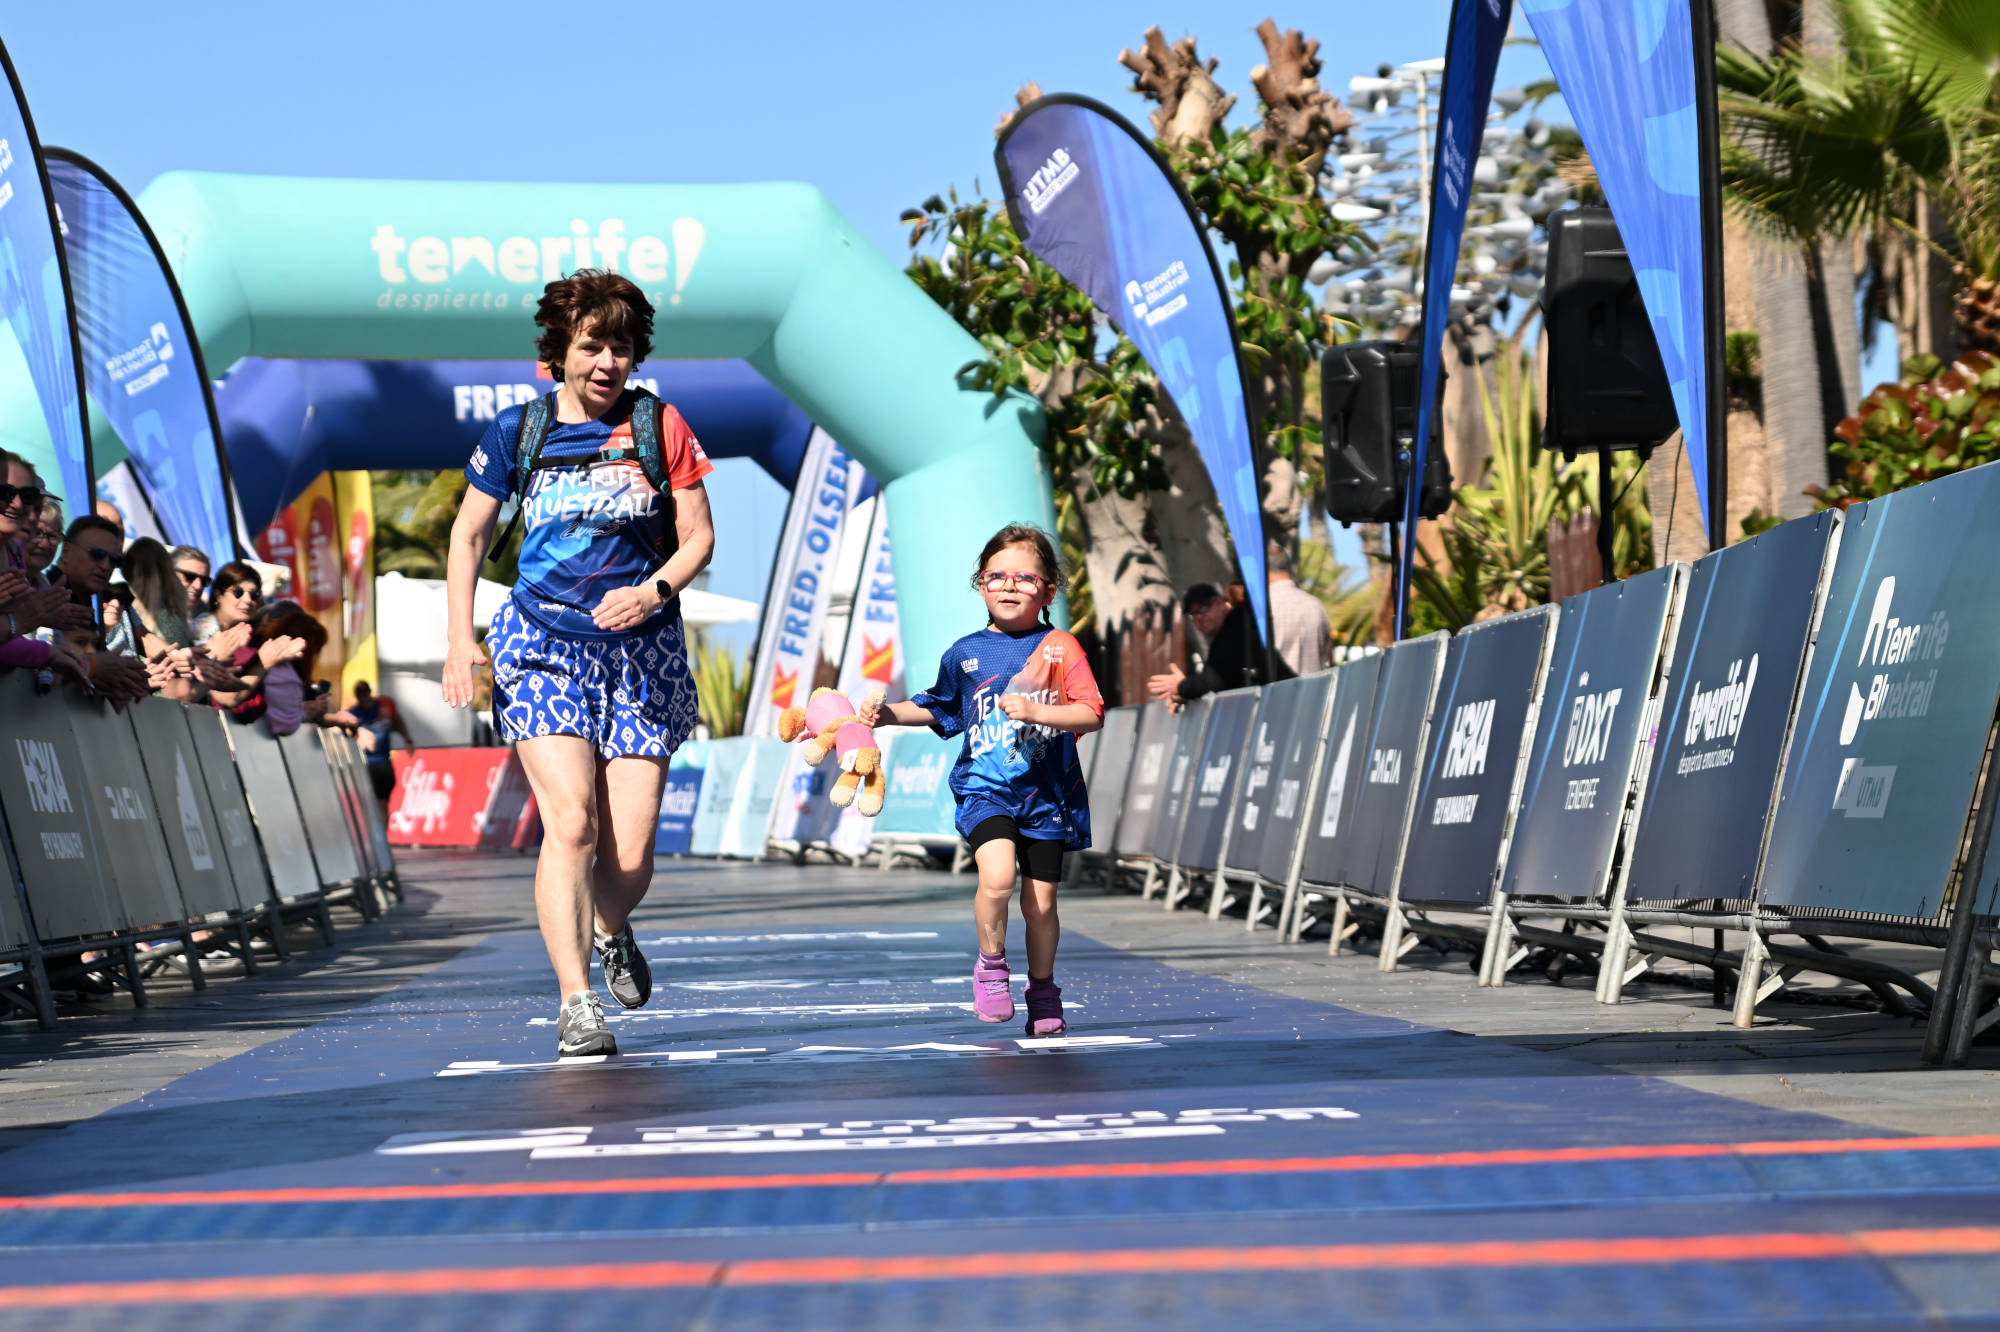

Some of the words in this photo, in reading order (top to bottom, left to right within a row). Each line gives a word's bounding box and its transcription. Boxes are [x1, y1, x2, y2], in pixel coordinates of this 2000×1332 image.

[1023, 148, 1071, 201] UTMB
[1142, 260, 1185, 292] Tenerife
[1146, 271, 1190, 304] Bluetrail
[522, 489, 659, 535] BLUETRAIL
[805, 441, 854, 555] OLSEN
[1880, 609, 1950, 666] Tenerife
[1863, 668, 1938, 721] Bluetrail
[1442, 699, 1496, 779] HOKA
[15, 738, 75, 814] HOKA
[1369, 748, 1402, 784] DACIA
[103, 786, 148, 820] DACIA
